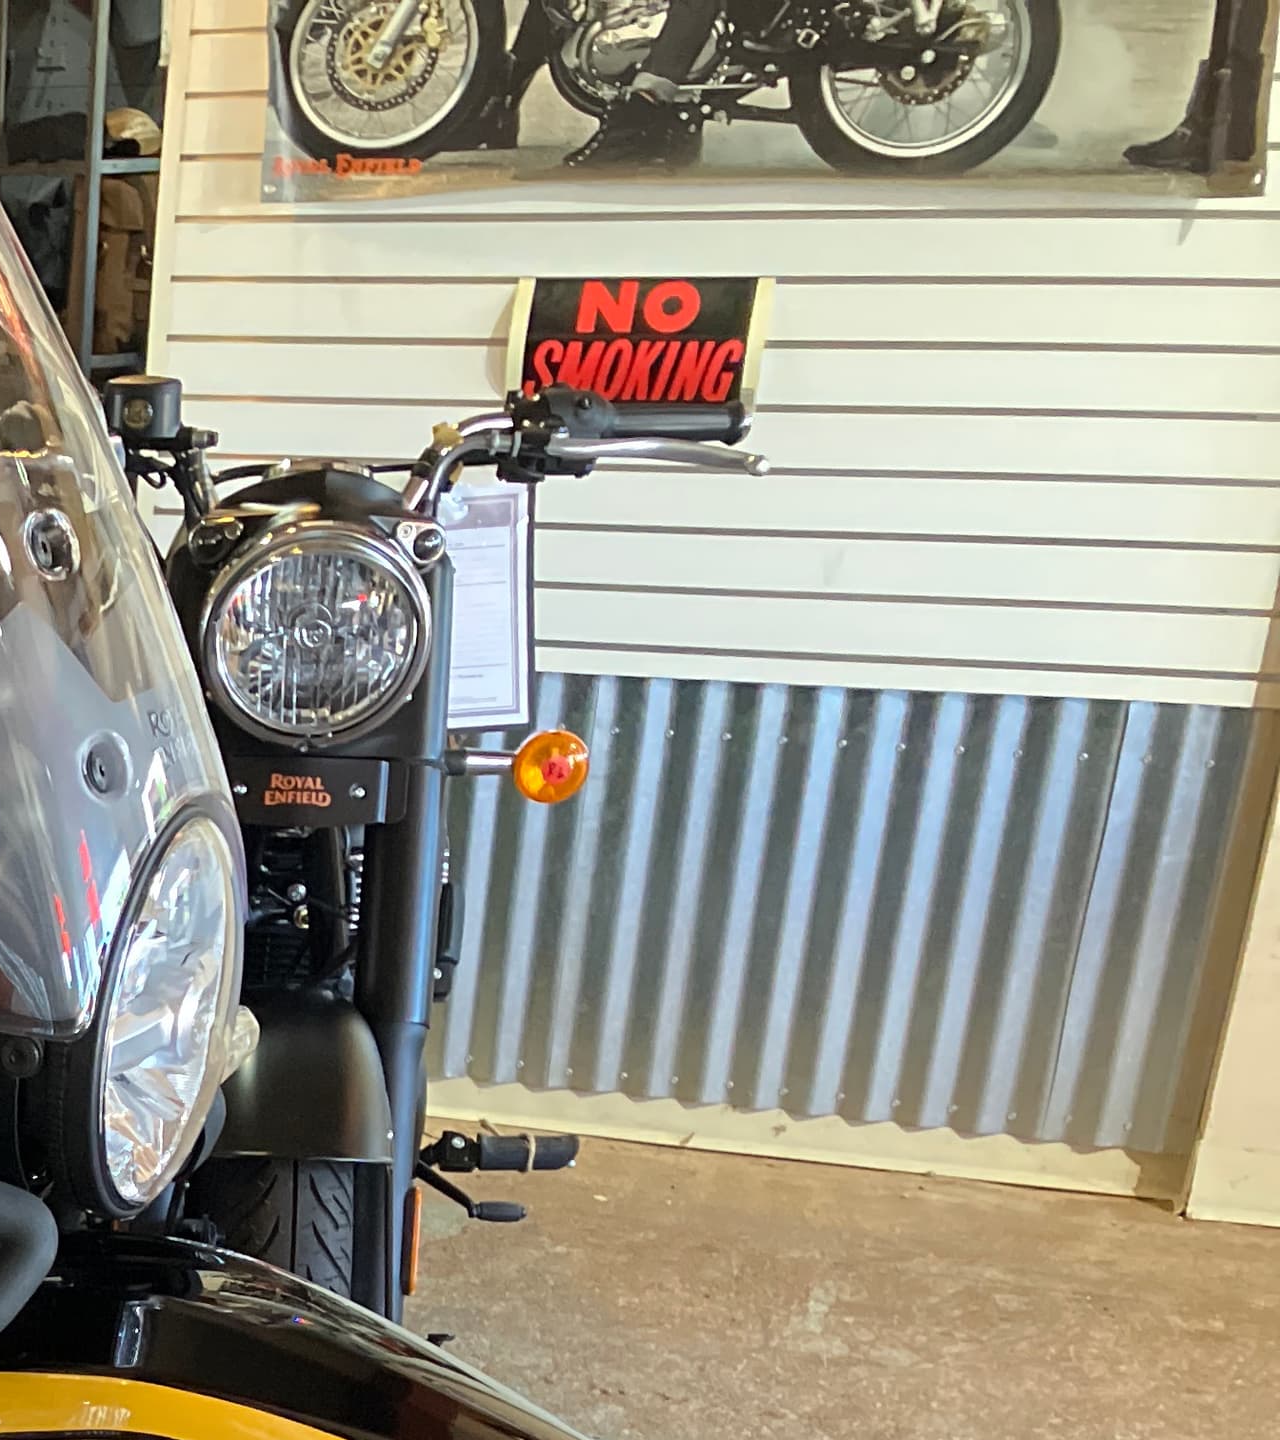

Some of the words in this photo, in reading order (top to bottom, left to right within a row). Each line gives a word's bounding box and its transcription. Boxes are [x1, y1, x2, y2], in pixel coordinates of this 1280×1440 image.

[576, 280, 701, 333] NO
[523, 338, 745, 401] SMOKING
[264, 789, 332, 808] ENFIELD
[270, 773, 325, 790] ROYAL
